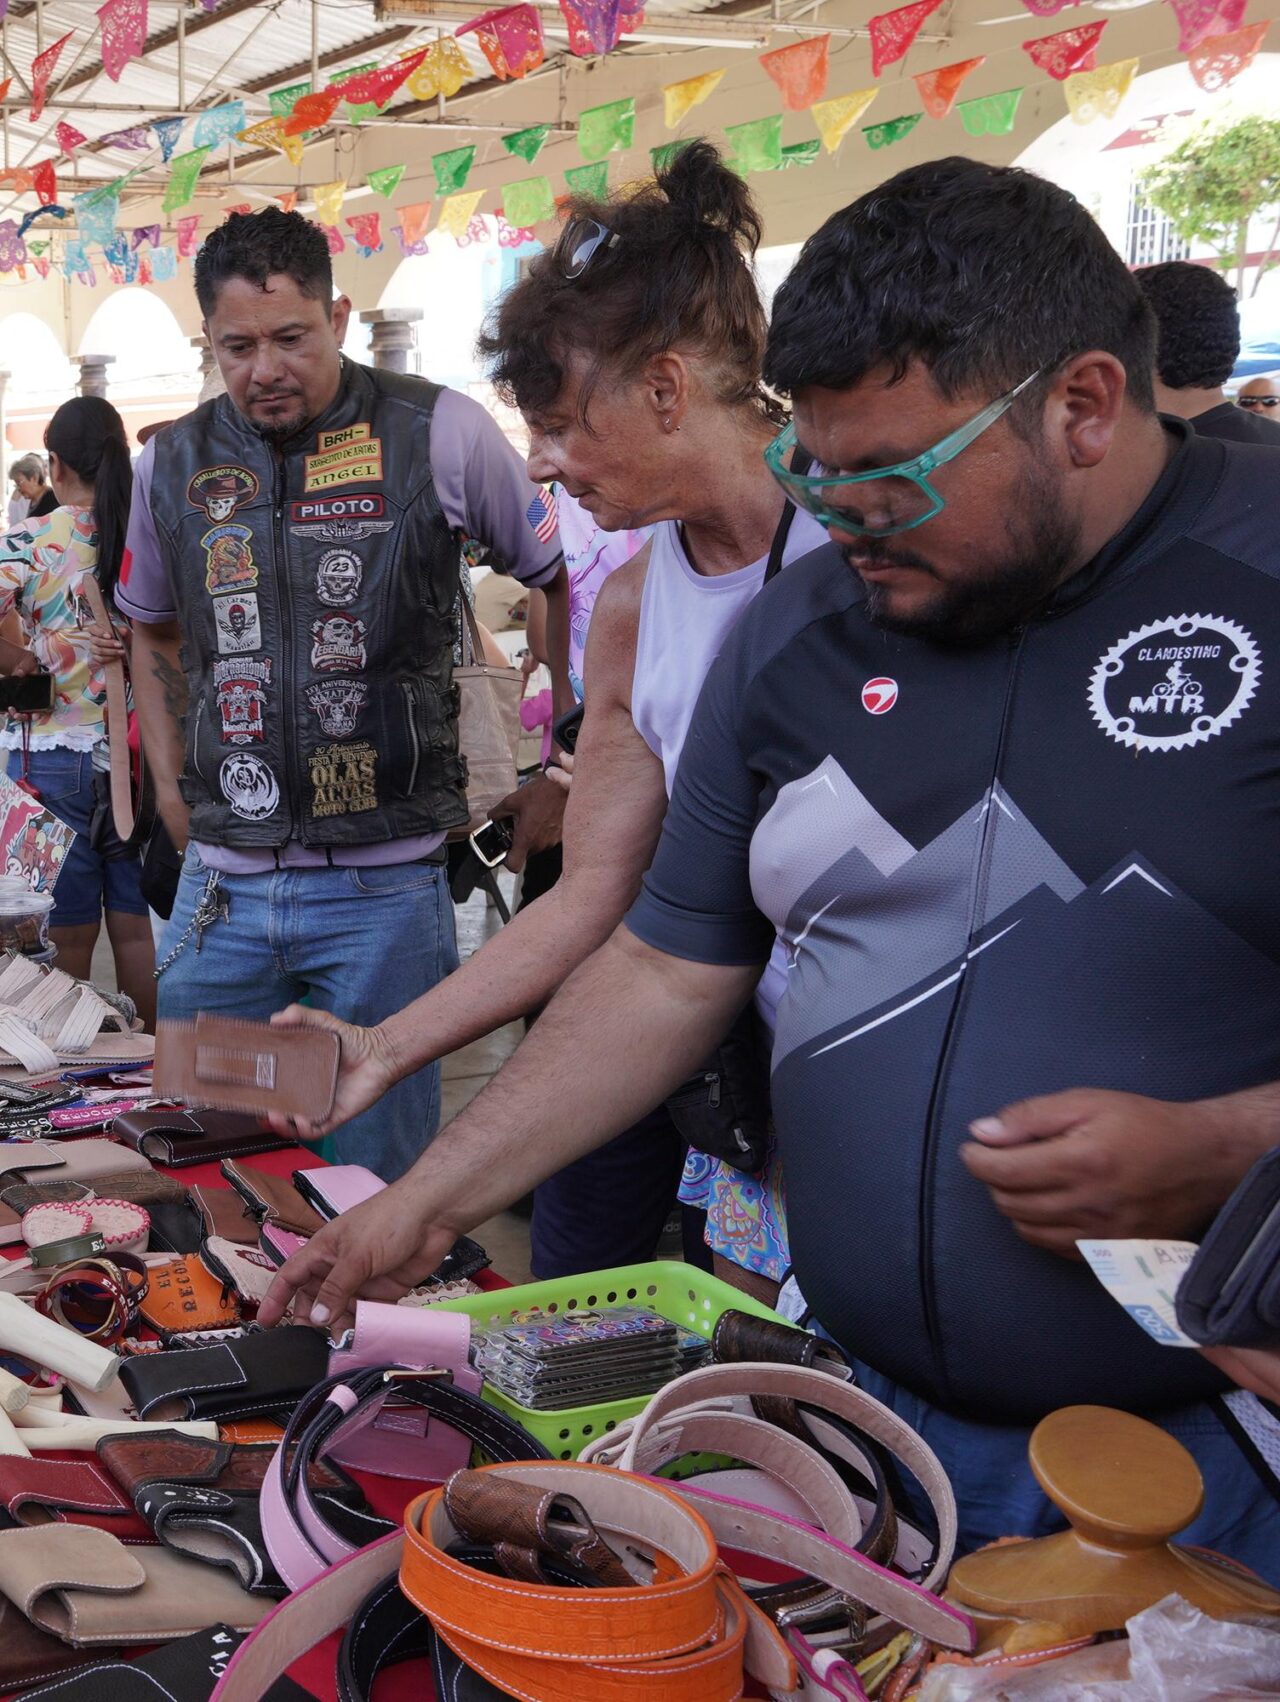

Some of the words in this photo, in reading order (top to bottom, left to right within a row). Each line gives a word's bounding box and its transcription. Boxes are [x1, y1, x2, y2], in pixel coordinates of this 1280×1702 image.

[310, 464, 376, 487] ANGEL
[301, 499, 374, 518] PILOTO
[332, 562, 349, 573] 23
[1138, 645, 1221, 661] CLANDESTINO
[322, 680, 367, 691] ANIVERSARIO
[308, 756, 331, 767] FIESTA
[311, 760, 375, 787] OLAS
[312, 780, 375, 804] ALTAS
[312, 802, 346, 817] MOTO
[60, 1107, 122, 1120] RECODO
[91, 1240, 106, 1252] EL
[101, 1278, 118, 1296] EL
[157, 1271, 171, 1289] EL
[1134, 1308, 1175, 1337] 500
